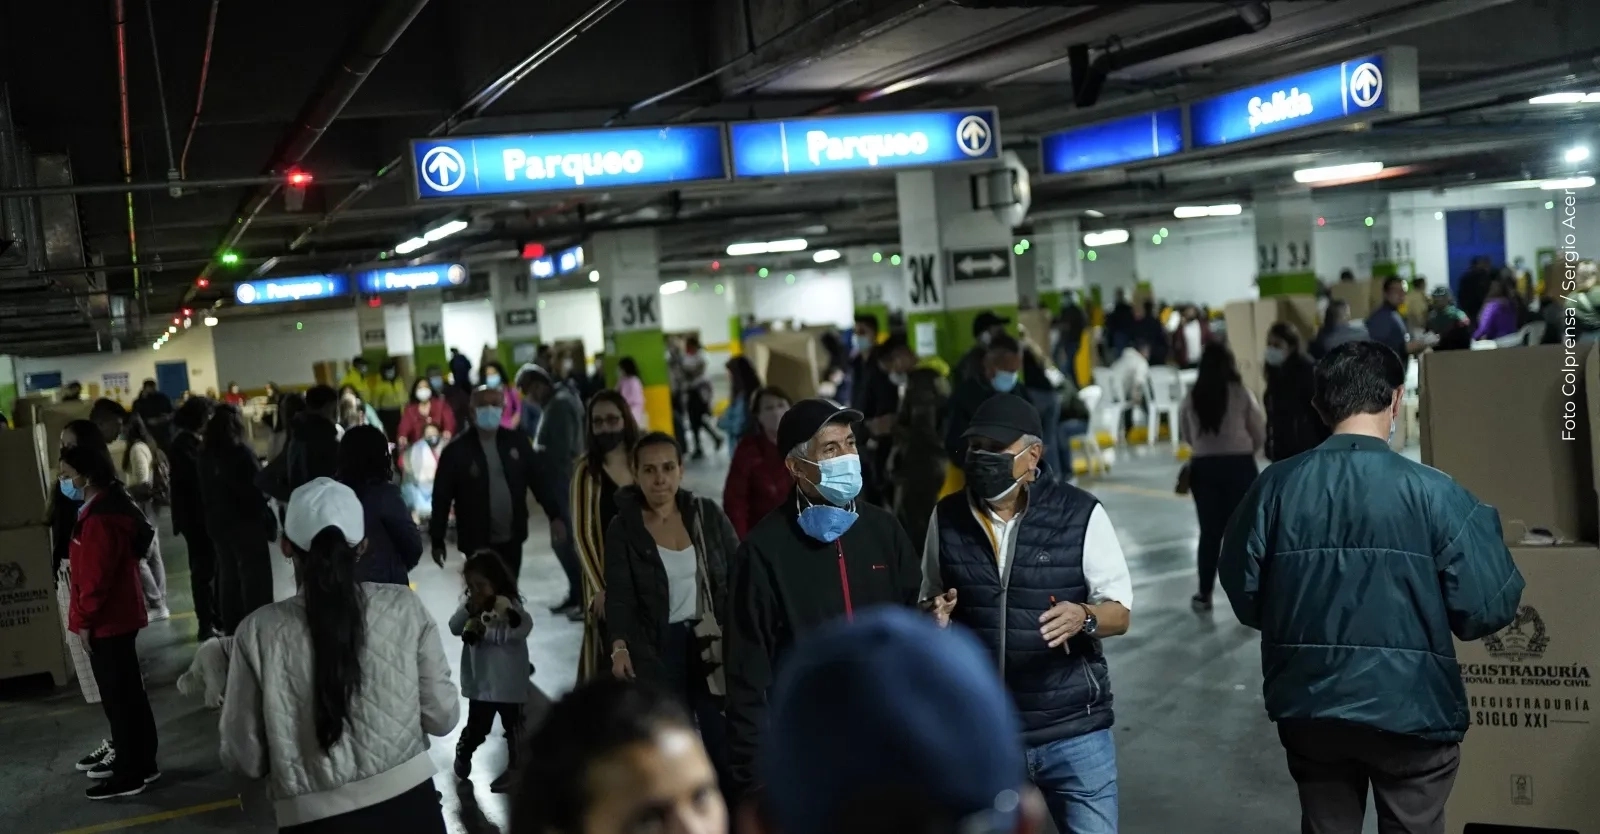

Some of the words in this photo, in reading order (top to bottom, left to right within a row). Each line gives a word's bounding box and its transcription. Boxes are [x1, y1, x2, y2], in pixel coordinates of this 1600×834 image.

[1248, 87, 1313, 129] Salida
[806, 129, 929, 167] Parqueo
[502, 148, 644, 185] Parqueo
[907, 254, 939, 305] 3K
[621, 294, 656, 326] 3K
[1459, 663, 1591, 679] EGISTRADURÍA
[1462, 677, 1495, 685] IONAL
[1498, 677, 1518, 685] DEL
[1521, 678, 1561, 687] ESTADO
[1563, 678, 1591, 688] CIVIL
[1471, 696, 1590, 711] REGISTRADURÍA
[1476, 711, 1518, 728] SIGLO
[1524, 712, 1548, 729] XXI
